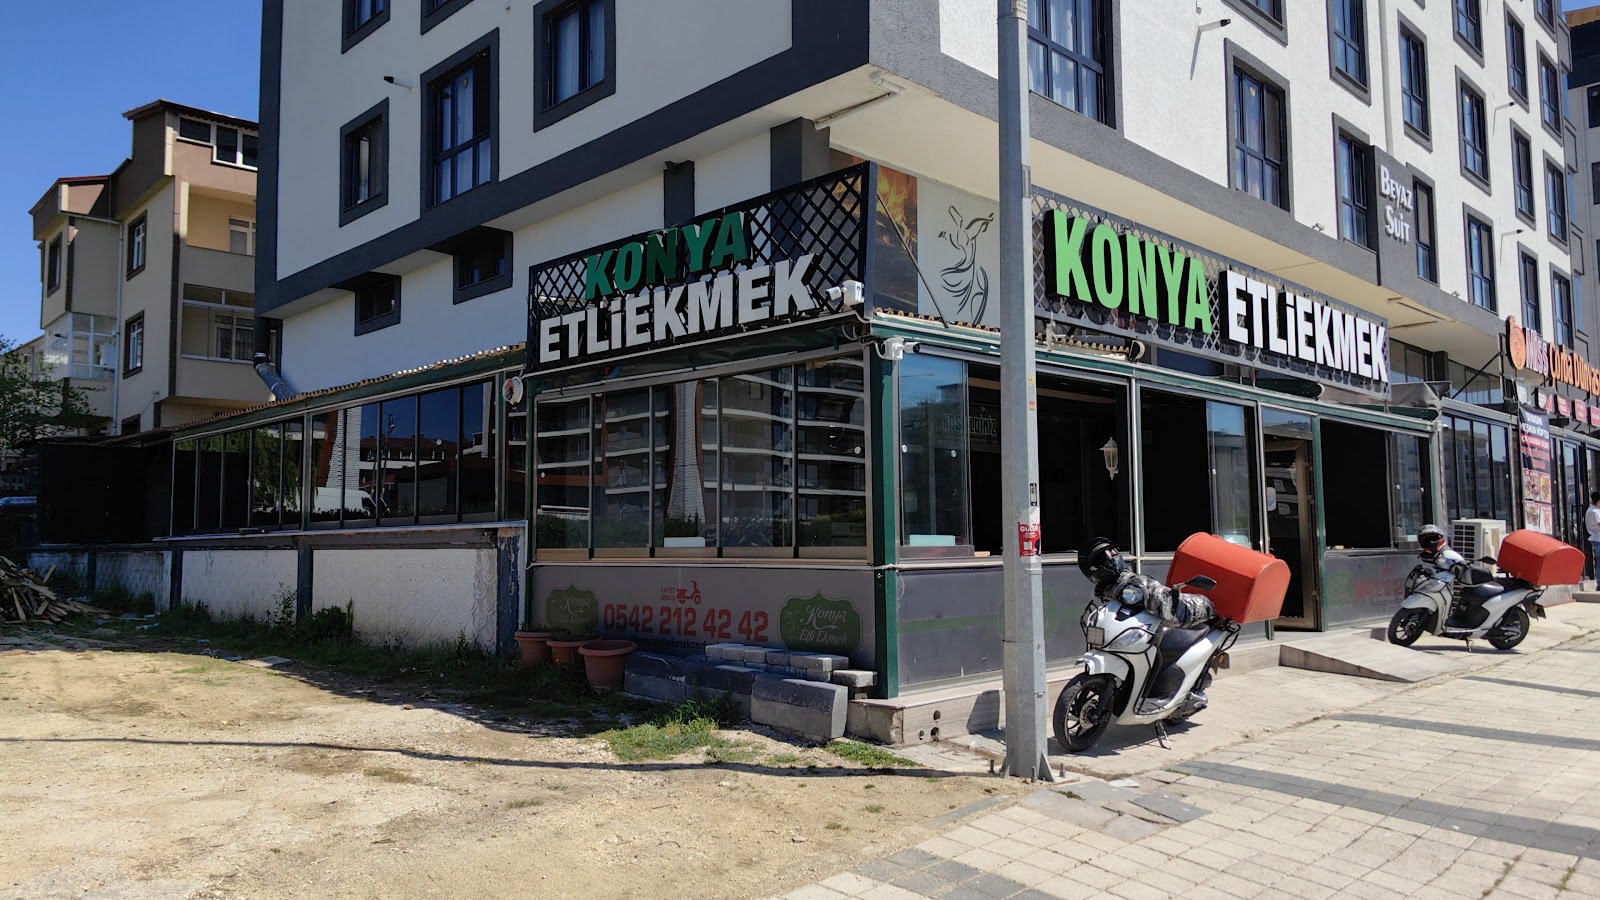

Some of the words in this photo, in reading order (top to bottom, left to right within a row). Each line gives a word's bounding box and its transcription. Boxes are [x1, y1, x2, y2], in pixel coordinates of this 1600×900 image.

[584, 210, 750, 300] KONYA
[1052, 208, 1213, 335] KONYA
[1573, 352, 1600, 399] Dünyas
[603, 603, 654, 634] 0542
[659, 606, 697, 637] 212
[702, 608, 732, 639] 42
[738, 609, 769, 642] 42
[799, 604, 848, 631] Konya
[799, 628, 816, 643] Etli
[816, 631, 848, 646] Ekmek
